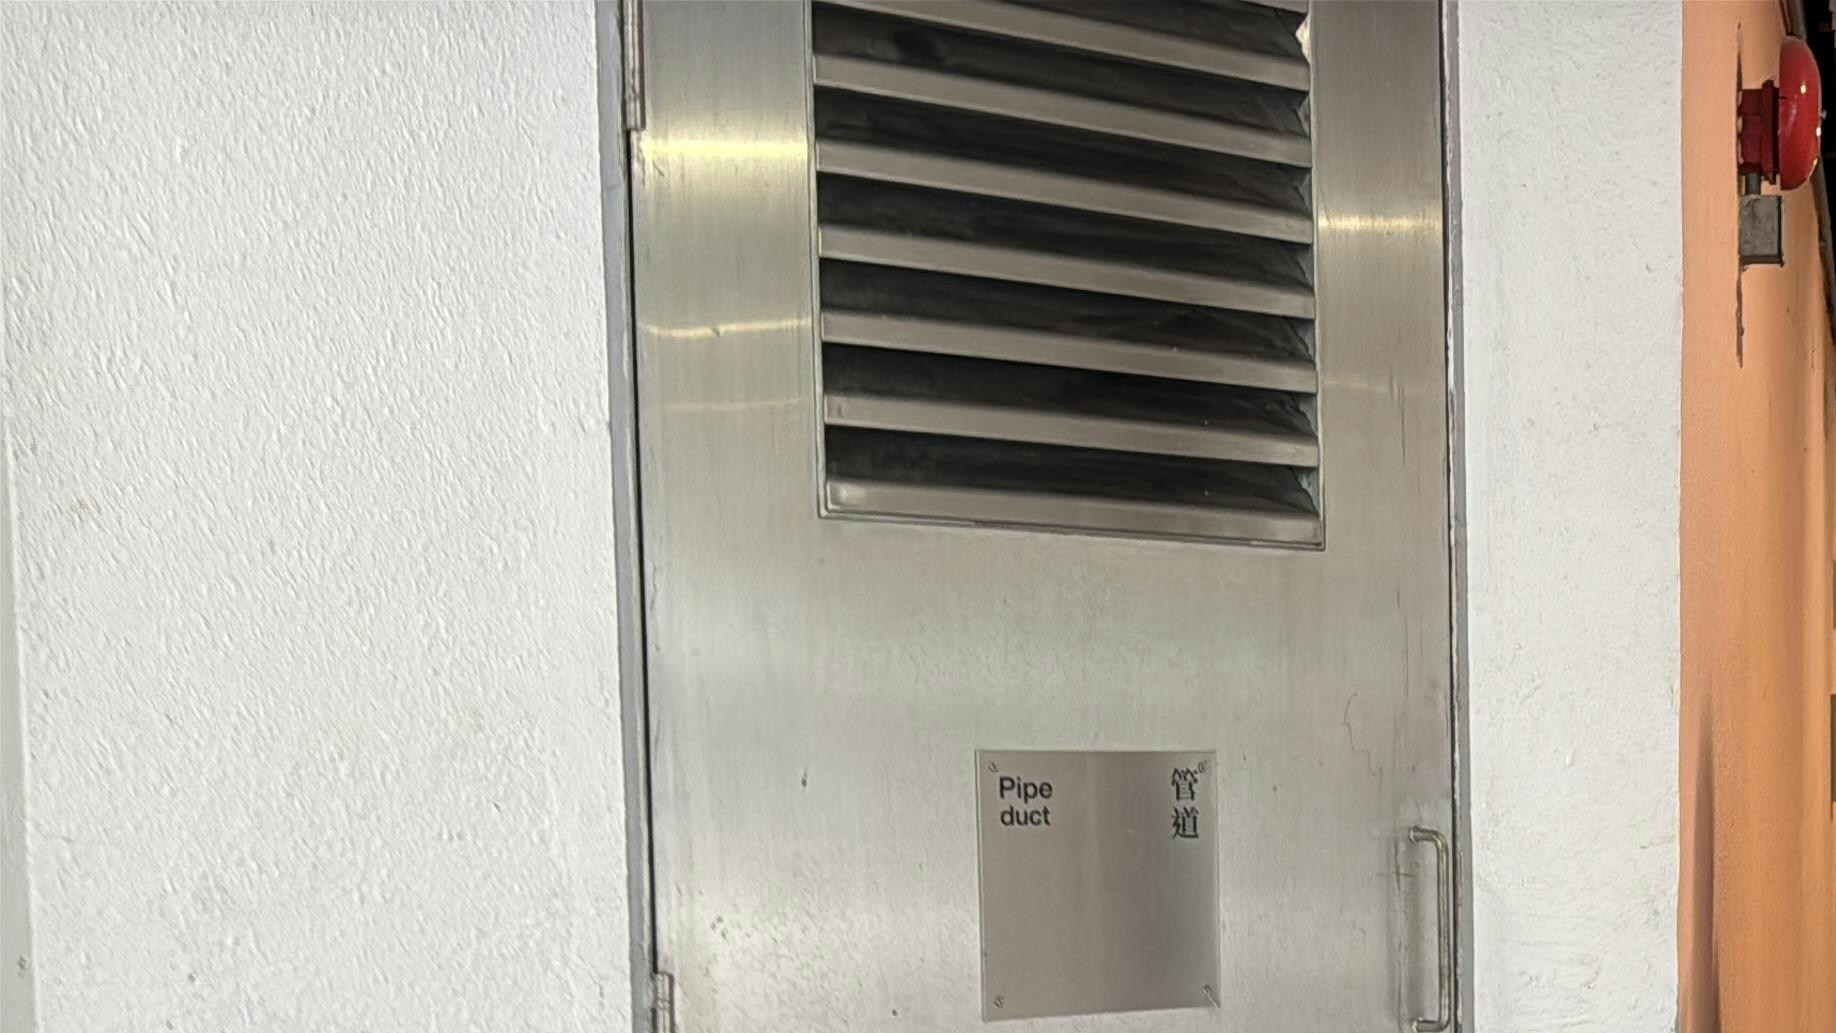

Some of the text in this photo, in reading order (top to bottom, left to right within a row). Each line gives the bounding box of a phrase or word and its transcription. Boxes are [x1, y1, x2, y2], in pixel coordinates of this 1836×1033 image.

[999, 776, 1053, 803] Pipe
[1171, 767, 1200, 839] 管道
[1000, 806, 1051, 826] duct
